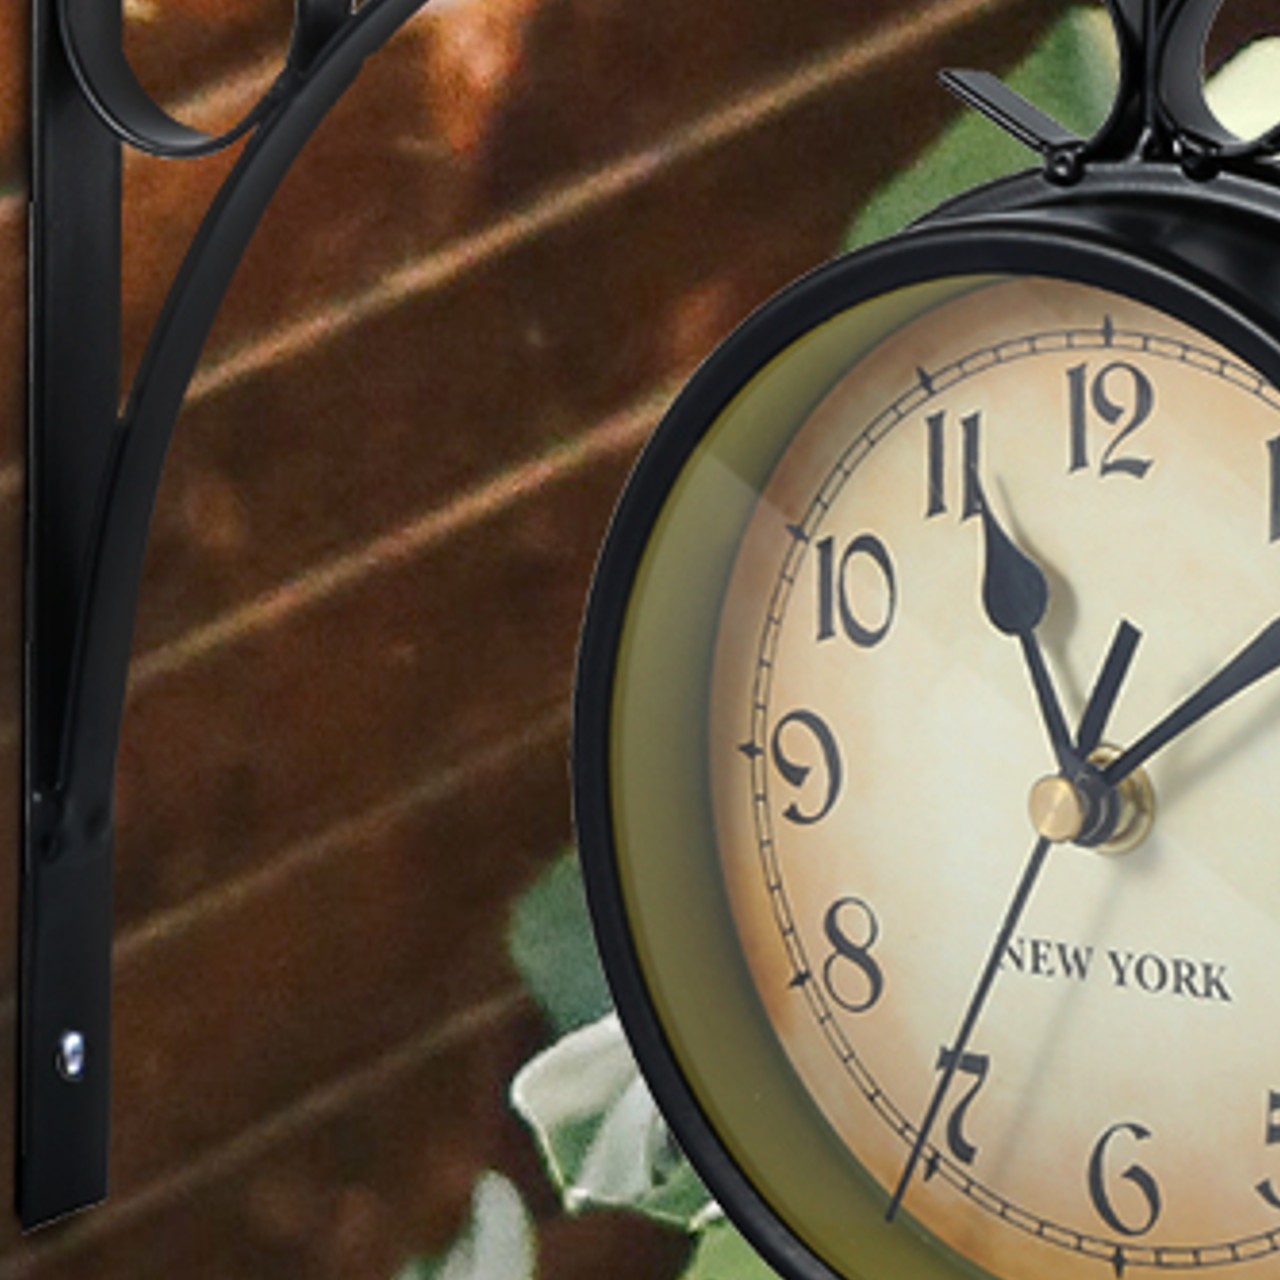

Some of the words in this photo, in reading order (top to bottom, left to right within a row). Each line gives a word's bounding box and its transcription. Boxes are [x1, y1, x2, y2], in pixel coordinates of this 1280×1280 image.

[924, 409, 981, 523] 11
[1067, 361, 1155, 479] 12
[815, 533, 897, 648] 10
[771, 708, 842, 825] 9
[823, 896, 883, 1012] 8
[999, 936, 1094, 981] NEW
[1107, 948, 1231, 1002] YORK
[936, 1045, 990, 1164] 7
[1087, 1121, 1161, 1236] 6
